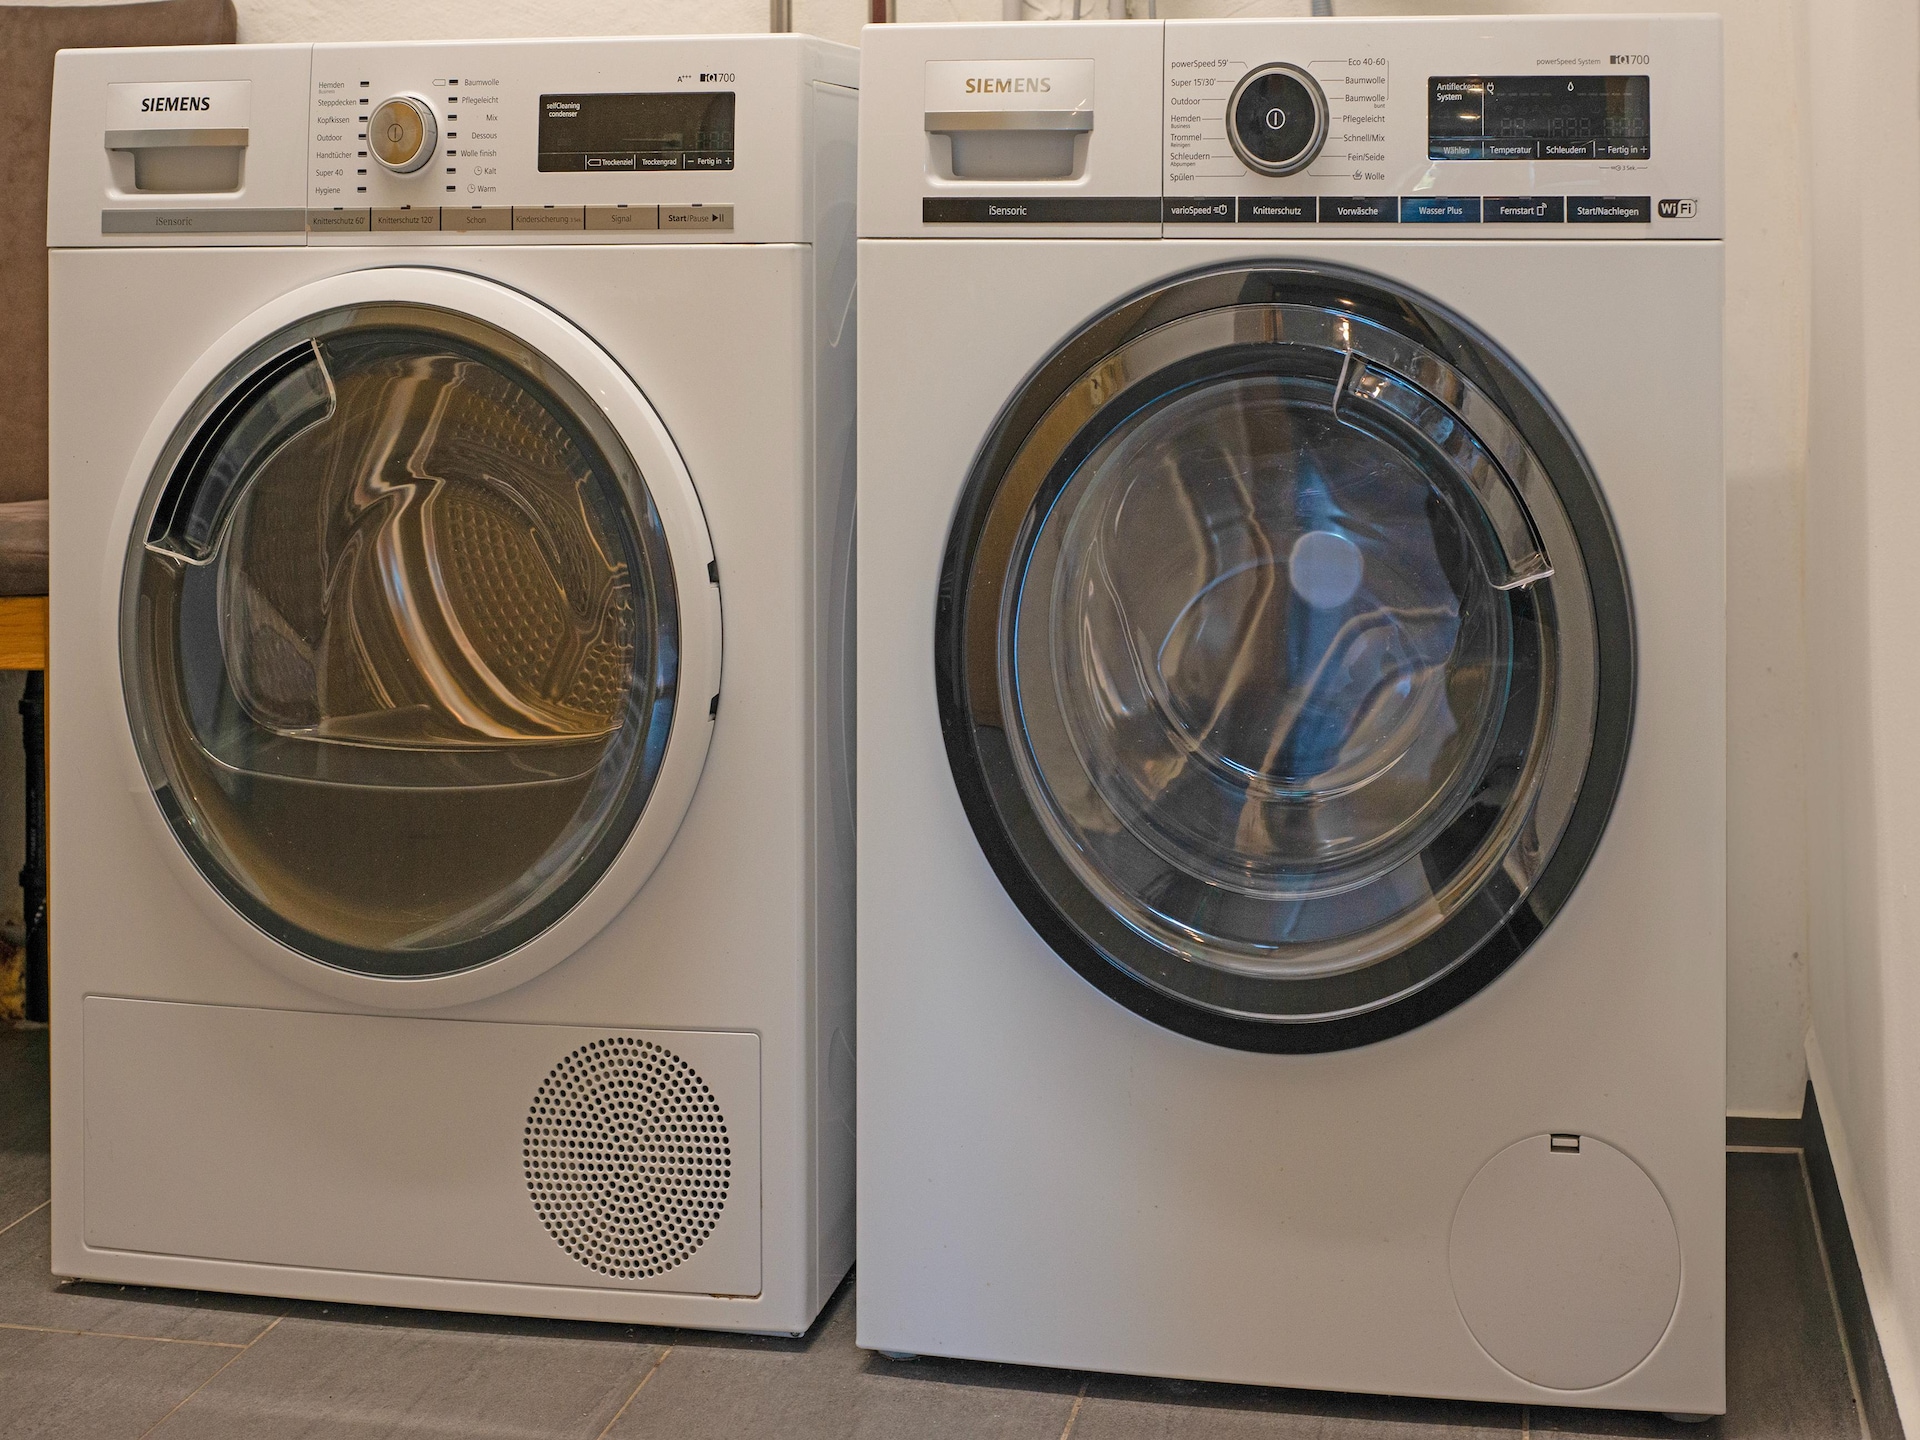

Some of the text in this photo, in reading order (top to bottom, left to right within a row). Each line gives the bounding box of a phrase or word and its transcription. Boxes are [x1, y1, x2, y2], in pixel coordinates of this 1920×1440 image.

[1171, 60, 1216, 69] powerSpeed
[1348, 58, 1386, 66] Eco 40-60
[1536, 58, 1601, 66] powerSpeed System
[1171, 79, 1192, 87] Super
[1345, 76, 1385, 84] Baumwolle
[318, 81, 344, 89] Hemden
[965, 77, 1051, 94] SIEMENS
[462, 96, 499, 105] Pflegeleicht
[1171, 97, 1201, 105] Outdoor
[1345, 94, 1385, 102] Baumwolle
[1437, 92, 1462, 102] System
[141, 96, 210, 112] SIEMENS
[318, 98, 357, 107] Steppdecken
[546, 102, 580, 110] selfCleaning
[486, 114, 498, 122] Mix
[549, 110, 577, 118] condenser
[317, 116, 350, 124] Kopfkissen
[1343, 115, 1385, 124] Pflegeleicht
[1343, 134, 1385, 142] Schnell/Mix
[479, 149, 497, 157] finish
[1444, 146, 1470, 155] Wählen
[1490, 146, 1532, 156] Temperatur
[1546, 146, 1586, 154] Schleudern
[1608, 145, 1638, 156] Fertig in
[316, 151, 352, 159] Handtücher
[1170, 152, 1210, 160] Schleudern
[1348, 153, 1385, 161] Fein/Seide
[602, 158, 633, 166] Trockenziel
[642, 158, 677, 166] Trockengrad
[697, 157, 722, 166] Fertig in
[315, 169, 333, 177] Super
[484, 167, 497, 175] Kalt
[1170, 173, 1194, 181] Spülen
[1365, 172, 1385, 180] Wolle
[315, 186, 341, 195] Hygiene
[477, 185, 496, 193] Warm
[989, 205, 1027, 216] iSensoric
[1171, 206, 1212, 215] varioSpeed
[1253, 206, 1302, 215] Knitterschutz
[1338, 206, 1379, 215] Vorwäsche
[1419, 206, 1462, 215] Wasser Plus
[1500, 206, 1534, 215] Fernstart
[1577, 206, 1639, 216] Start/Nachlegen
[155, 216, 192, 226] iSensoric
[313, 217, 354, 225] Knitterschutz
[378, 216, 419, 224] Knitterschutz
[466, 216, 486, 224] Schon
[516, 215, 569, 225] Kindersicherung
[611, 214, 632, 223] Signal
[668, 214, 709, 223] Start/Pause
